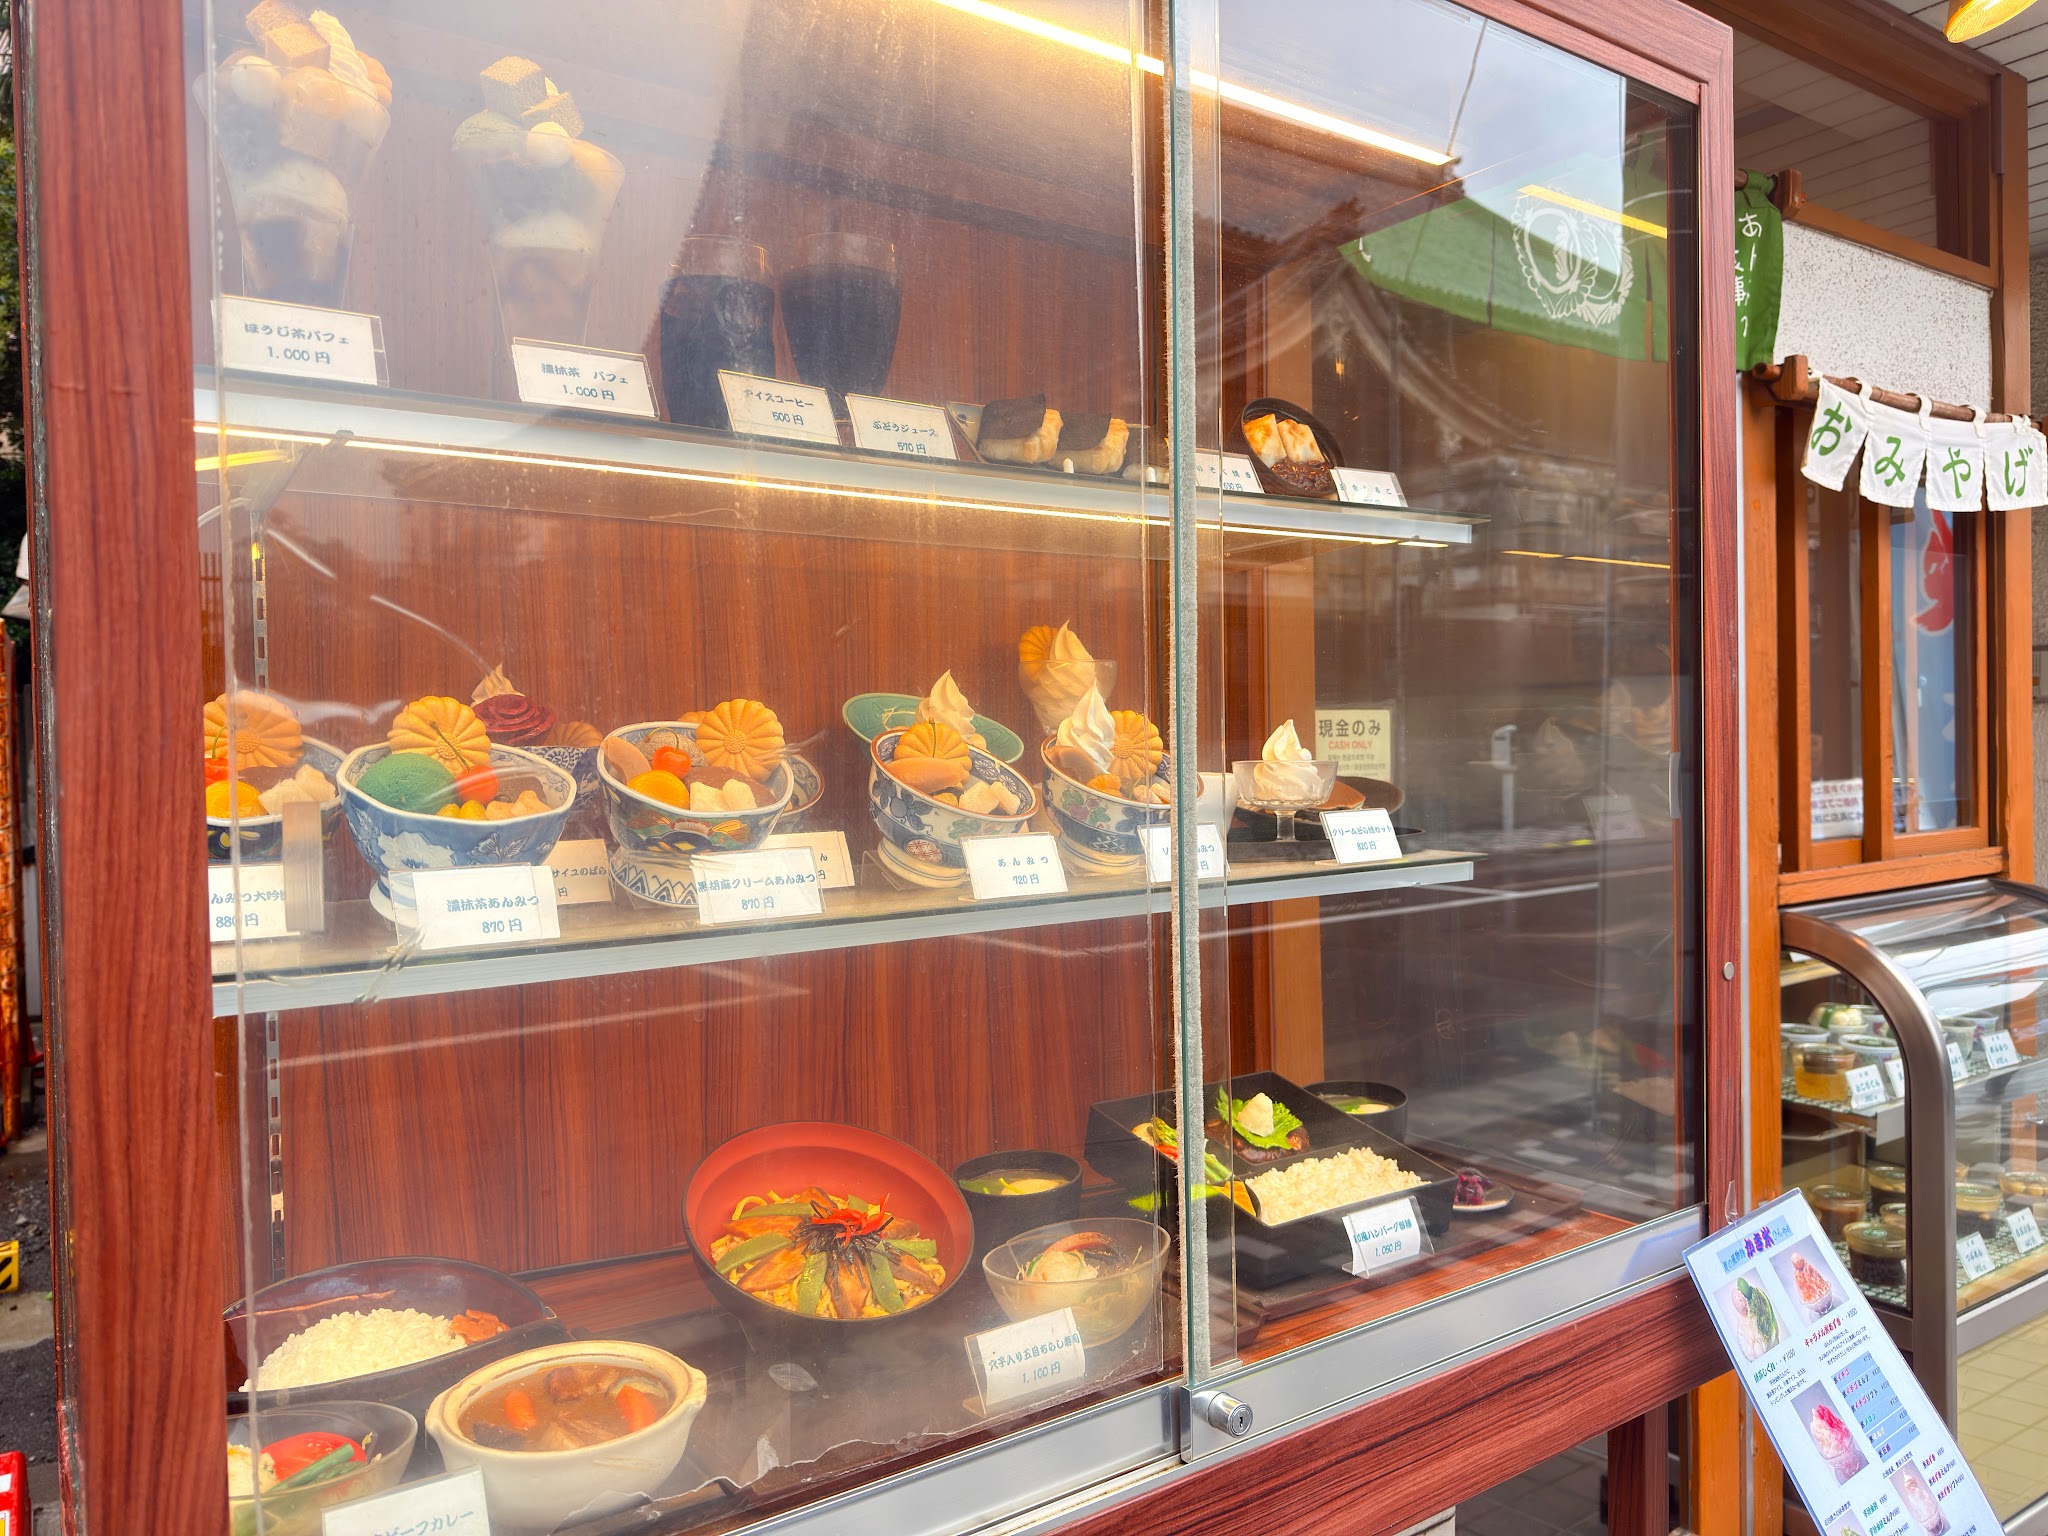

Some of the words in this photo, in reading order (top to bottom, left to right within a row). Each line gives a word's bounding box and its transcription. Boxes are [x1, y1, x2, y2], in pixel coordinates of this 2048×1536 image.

[244, 322, 350, 344] ほうじ茶パフェ
[1811, 401, 2034, 499] おみやげ
[1318, 719, 1381, 738] 現金のみ
[1328, 741, 1350, 750] CASH
[1352, 740, 1373, 750] ONLY
